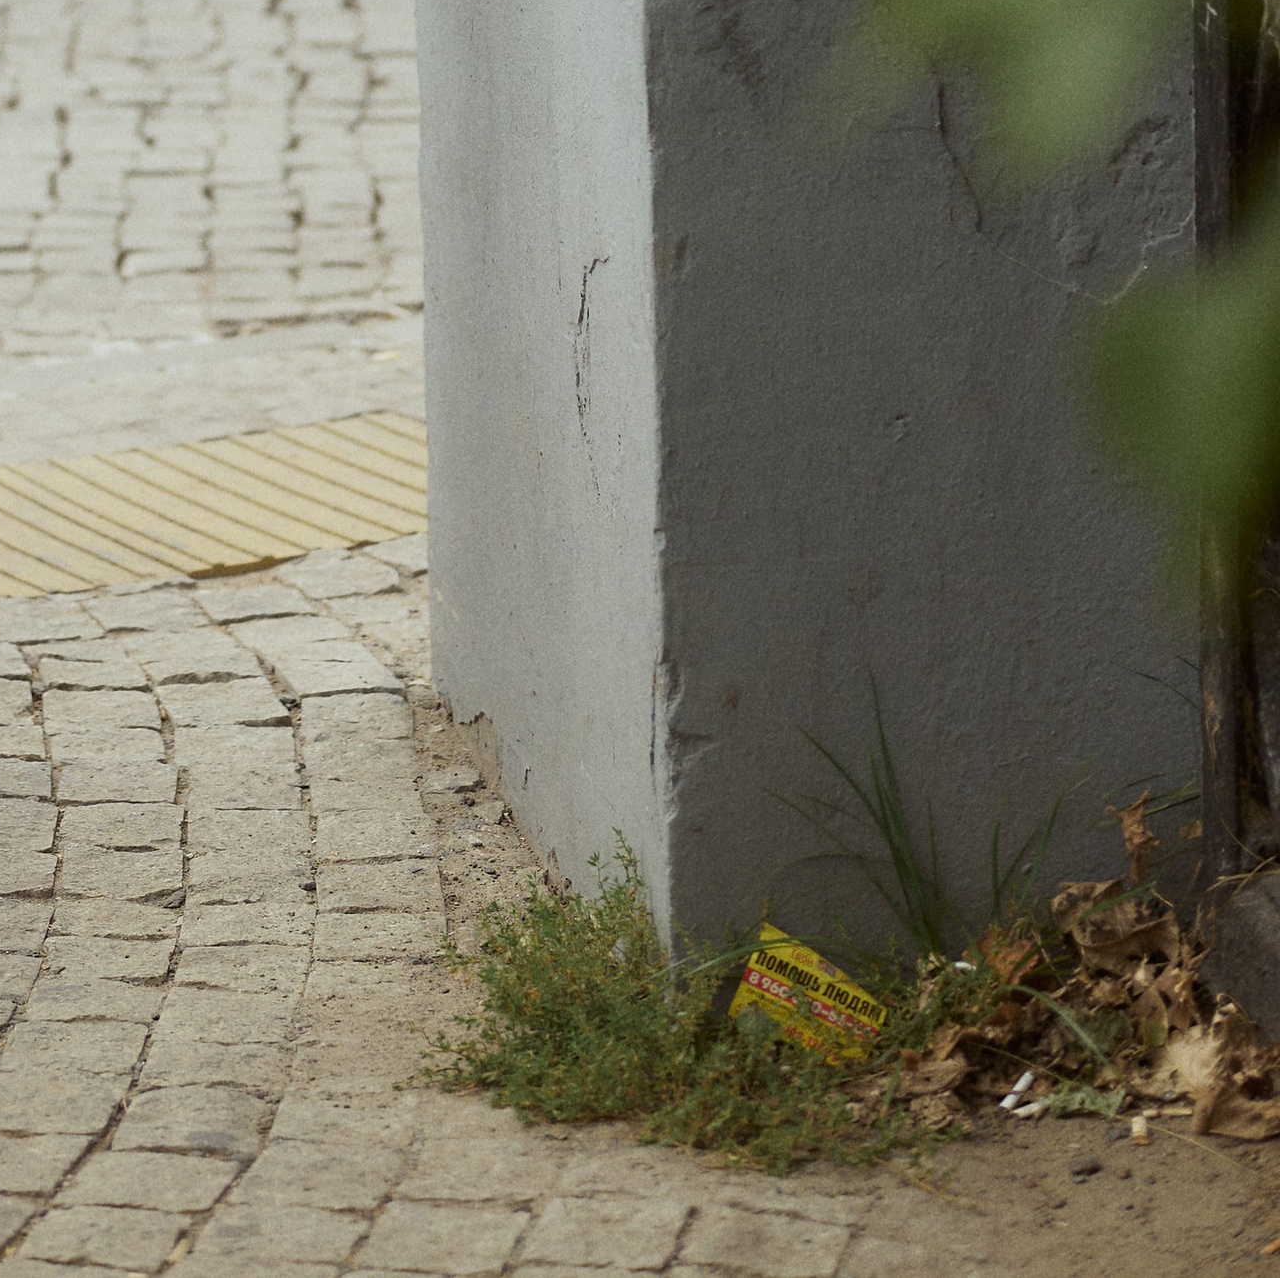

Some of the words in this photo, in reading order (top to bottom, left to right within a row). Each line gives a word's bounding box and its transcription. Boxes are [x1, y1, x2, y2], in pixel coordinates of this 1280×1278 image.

[748, 971, 760, 985] 8
[755, 950, 820, 994] ПОМОЩЬ
[821, 982, 882, 1023] ЛЮДЯМ
